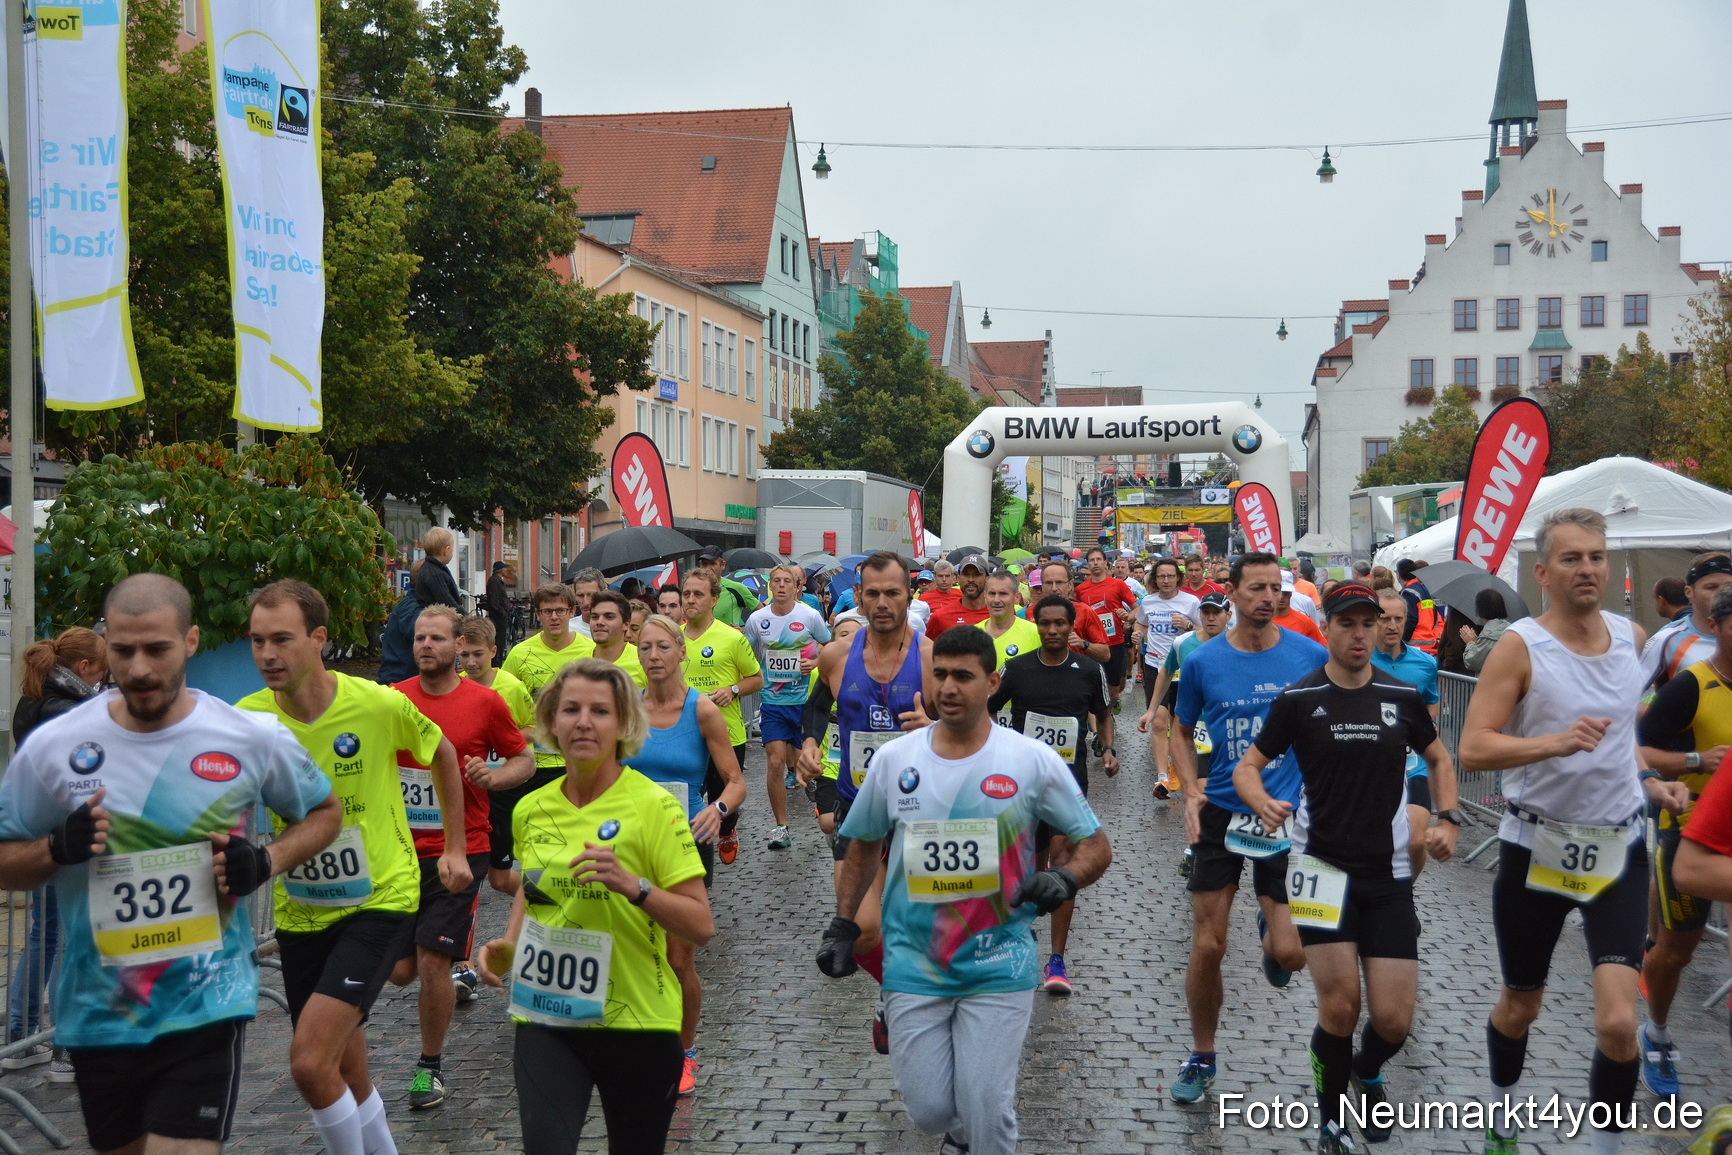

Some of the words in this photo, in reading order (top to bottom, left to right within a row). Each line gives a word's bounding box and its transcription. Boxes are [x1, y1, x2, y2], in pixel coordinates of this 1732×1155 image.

[224, 83, 273, 111] Fairtrde
[1004, 416, 1080, 440] BMW
[1087, 415, 1222, 443] Laufsport
[1462, 422, 1538, 571] REWE
[1161, 510, 1188, 520] ZIEL
[769, 657, 798, 671] 2907
[872, 709, 890, 721] a3
[1330, 724, 1343, 732] LLC
[1345, 723, 1380, 731] Marathon
[1034, 726, 1067, 747] 236
[1334, 732, 1378, 741] Regensburg
[197, 758, 236, 775] Hervis
[334, 759, 363, 773] Partl
[335, 769, 363, 778] Neumarkt
[68, 779, 106, 790] PARTL
[985, 780, 1014, 793] Hervis
[340, 795, 356, 806] EXT
[898, 798, 920, 806] PARTL
[408, 811, 439, 821] Jochen
[943, 821, 989, 833] BOCK
[1240, 837, 1282, 852] Reinhard
[141, 848, 201, 869] BOCK
[923, 840, 980, 872] 333
[1561, 842, 1599, 872] 36
[287, 846, 361, 882] 2880
[552, 877, 569, 888] THE
[932, 879, 973, 892] Ahmad
[1291, 870, 1319, 899] 91
[1562, 876, 1587, 891] Lars
[113, 873, 194, 923] 332
[307, 885, 347, 899] Marcel
[576, 889, 611, 901] YEARS
[131, 926, 182, 950] Jamal
[549, 929, 602, 949] BOCK
[520, 943, 600, 994] 2909
[532, 993, 573, 1016] Nicola
